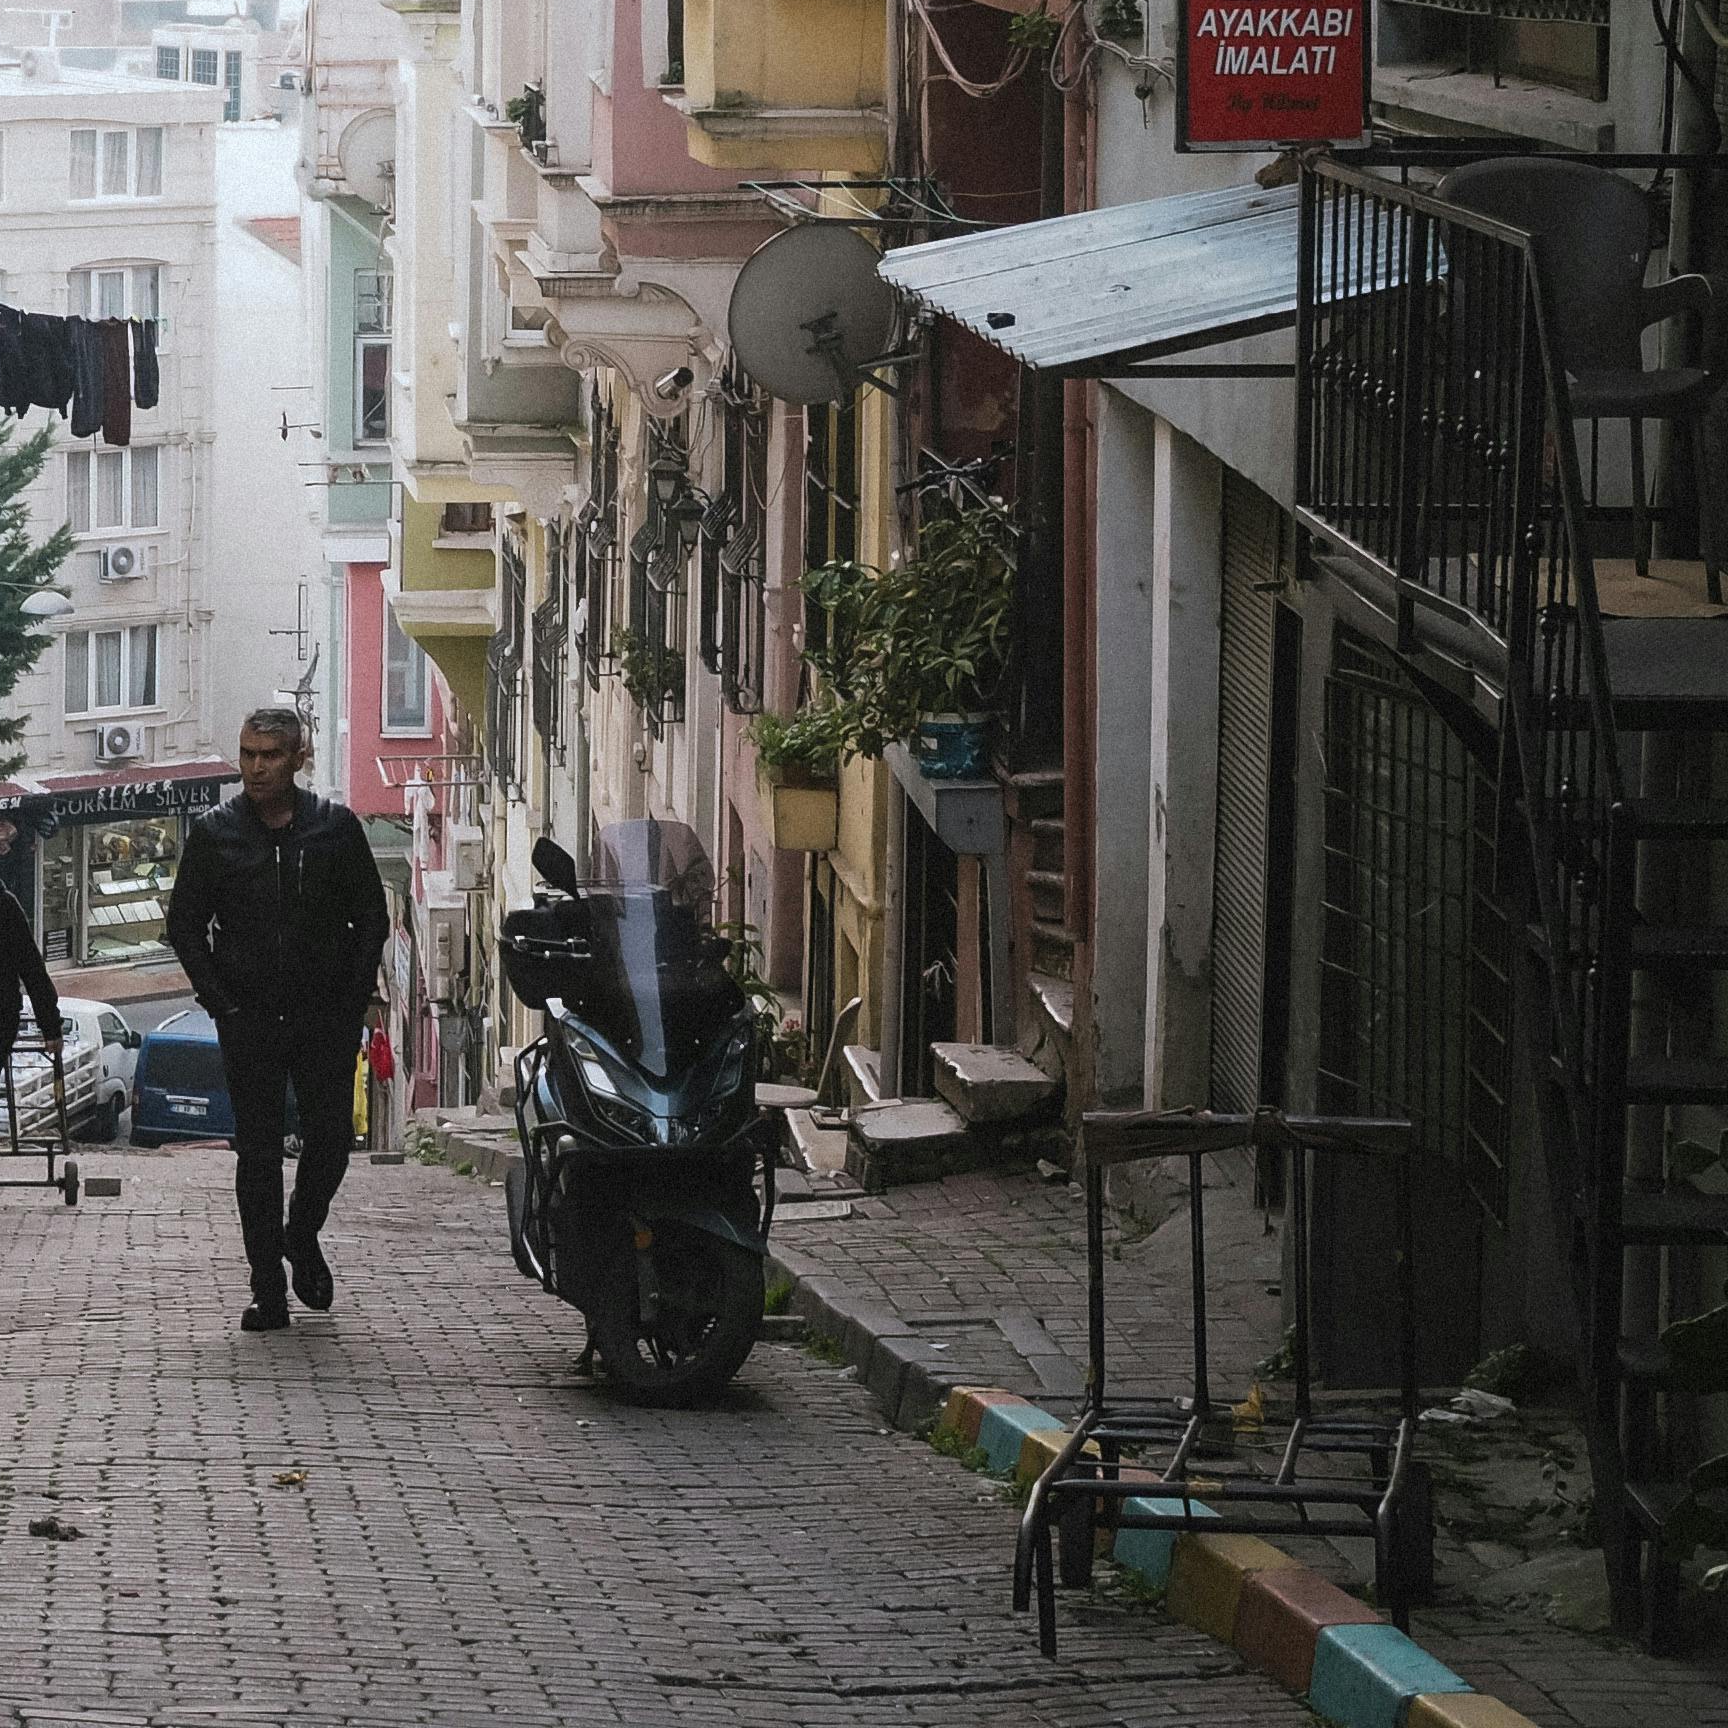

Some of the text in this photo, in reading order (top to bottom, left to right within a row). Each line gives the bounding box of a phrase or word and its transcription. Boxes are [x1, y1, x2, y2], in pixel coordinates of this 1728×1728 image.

[1196, 8, 1353, 38] AYAKKABI
[1214, 40, 1337, 75] İMALATI
[156, 785, 211, 806] SILVER
